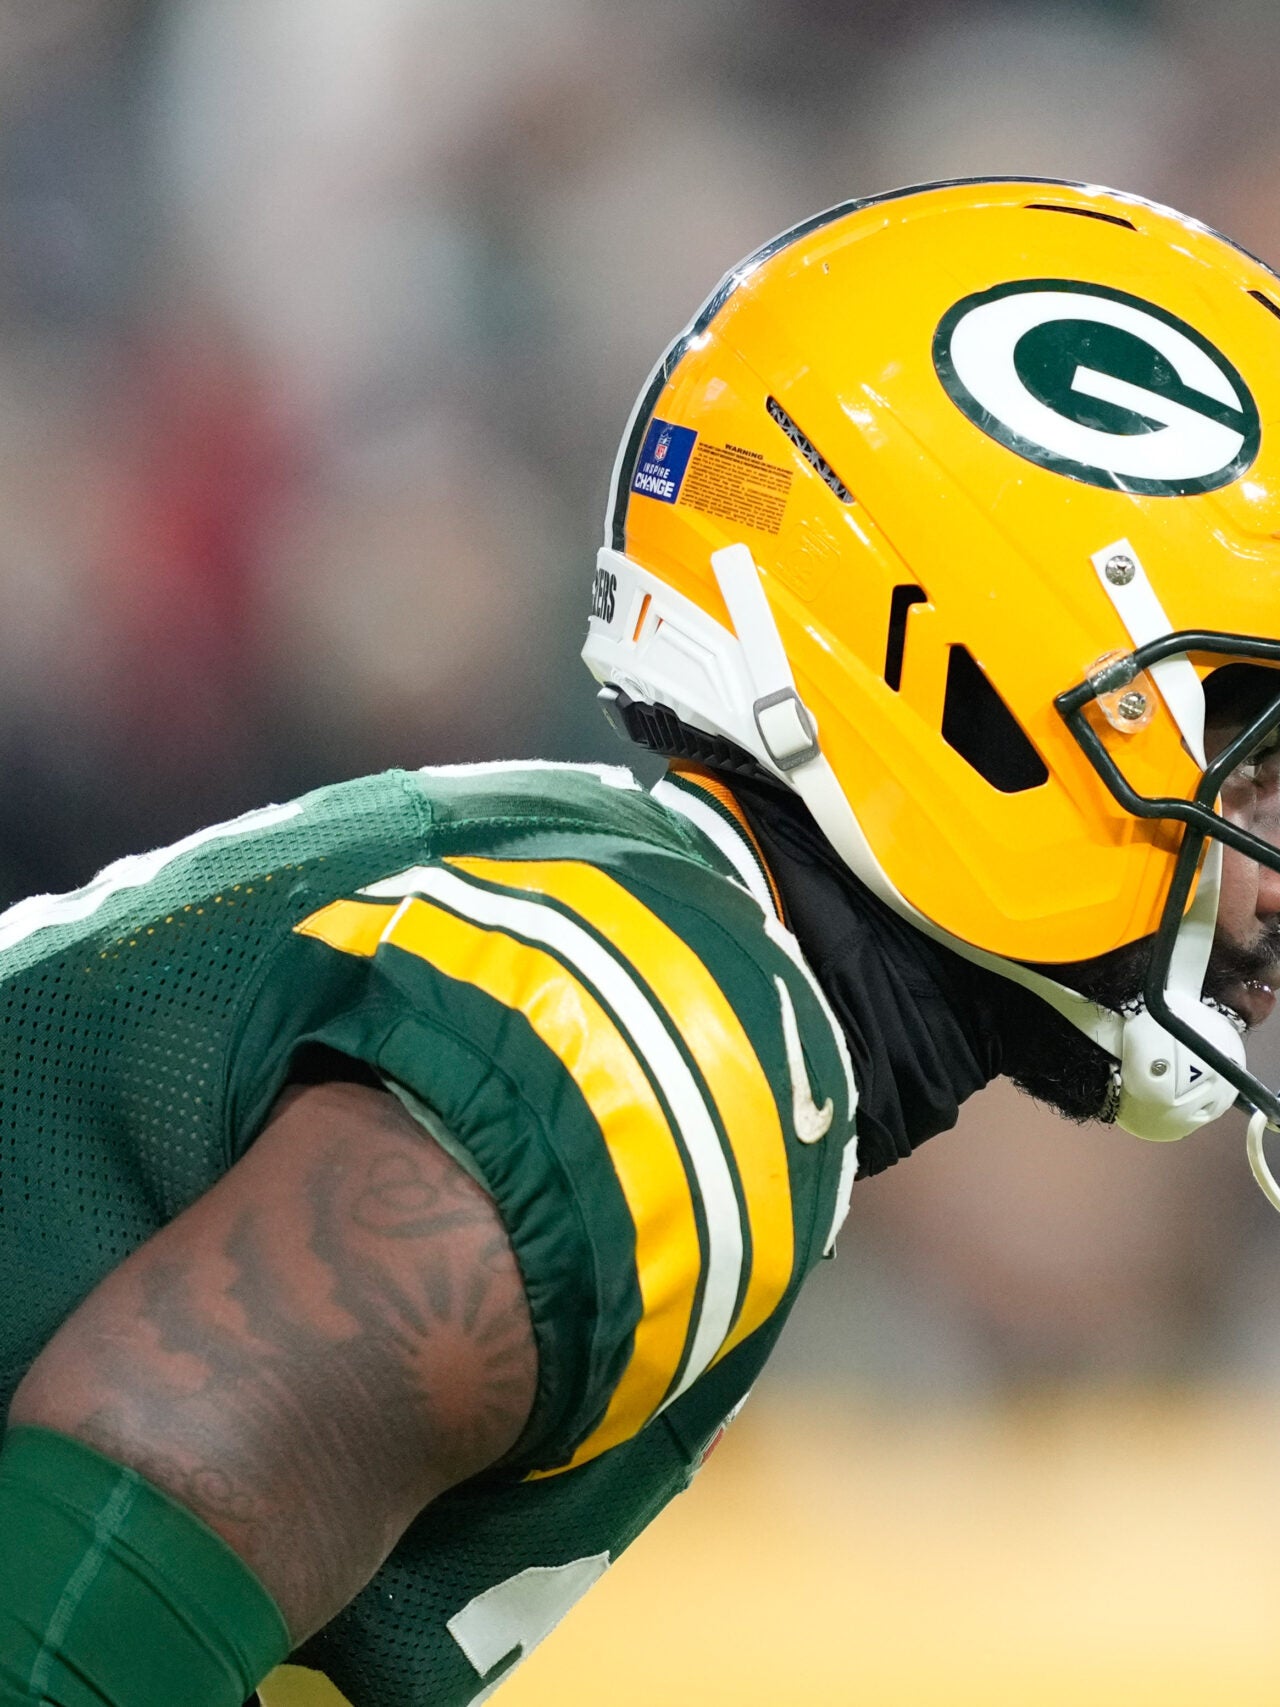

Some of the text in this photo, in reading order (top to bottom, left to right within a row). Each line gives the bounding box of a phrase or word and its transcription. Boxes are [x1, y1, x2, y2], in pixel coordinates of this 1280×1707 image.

[948, 290, 1246, 481] G
[724, 443, 764, 461] WARNING
[643, 462, 671, 479] INSPIRE
[634, 472, 675, 498] CHANGE
